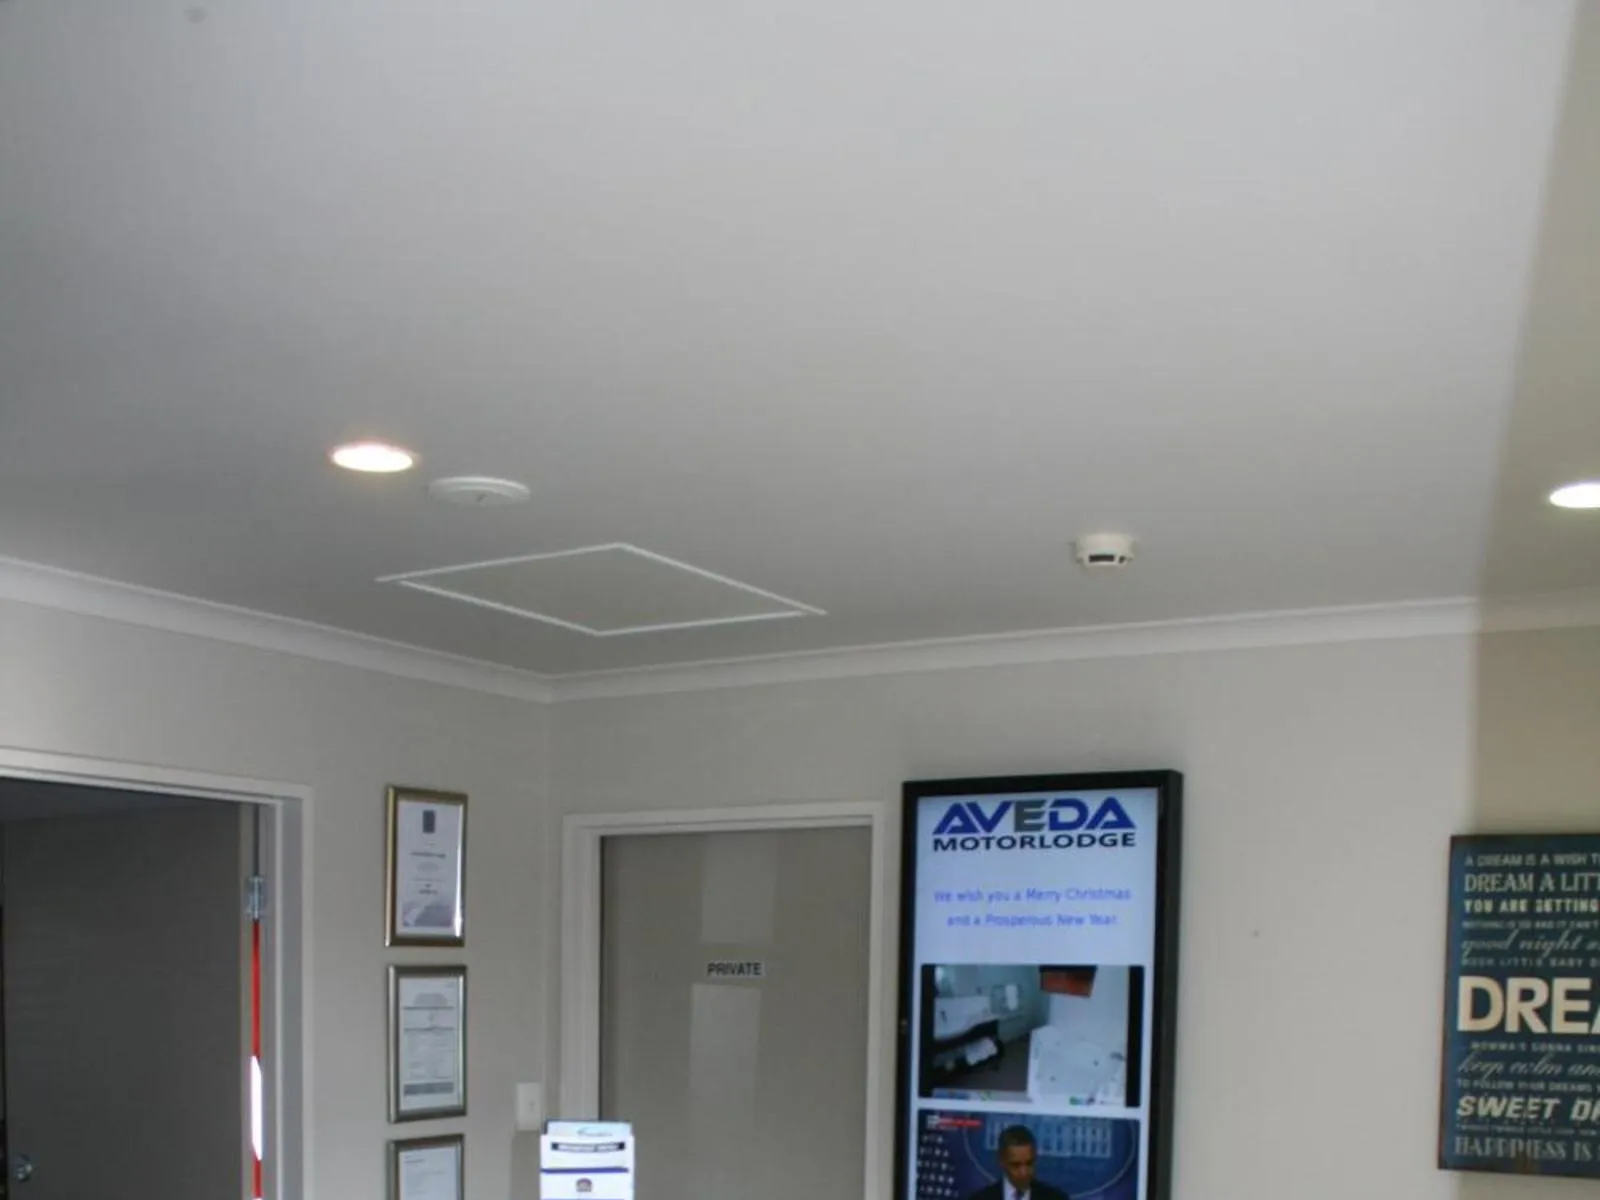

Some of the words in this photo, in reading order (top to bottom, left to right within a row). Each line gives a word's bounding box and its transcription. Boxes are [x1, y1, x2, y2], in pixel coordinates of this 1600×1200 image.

[932, 797, 1137, 835] AVEDA
[933, 832, 1137, 852] MOTORLODGE
[1464, 873, 1534, 892] DREAM
[1539, 872, 1555, 892] A
[1026, 886, 1061, 904] Merry
[1064, 886, 1132, 902] Christmas
[1464, 899, 1493, 914] YOU
[707, 962, 762, 976] PRIVATE
[1456, 1095, 1561, 1119] SWEET
